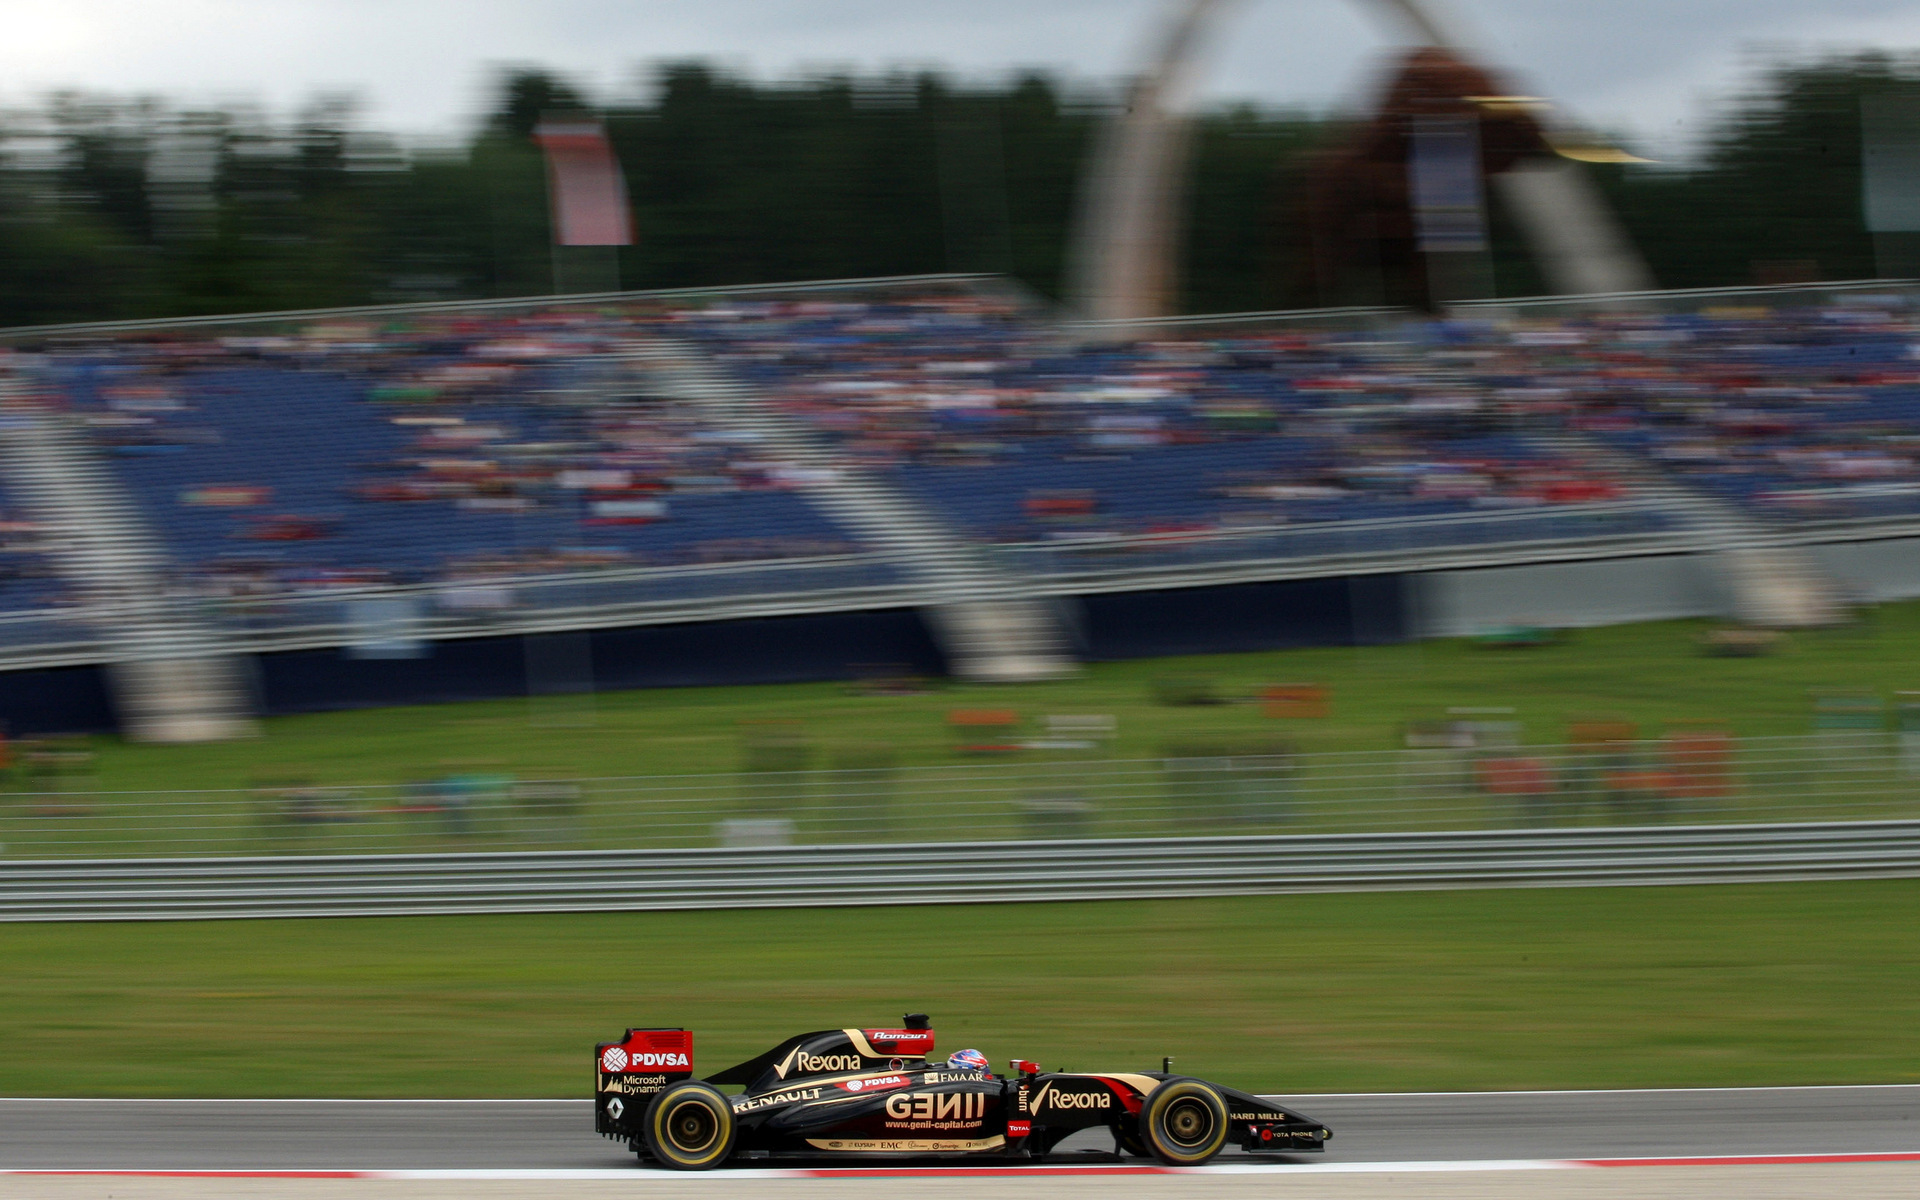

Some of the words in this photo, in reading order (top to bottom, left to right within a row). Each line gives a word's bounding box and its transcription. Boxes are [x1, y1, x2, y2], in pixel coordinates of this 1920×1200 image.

[873, 1032, 928, 1040] Romain
[632, 1053, 689, 1066] PDVSA
[797, 1051, 861, 1072] Rexona
[623, 1075, 667, 1085] Microsoft
[864, 1076, 901, 1087] PDVSA
[940, 1073, 984, 1083] EMAAR
[732, 1088, 823, 1114] RENAULT
[1018, 1090, 1030, 1112] burn
[1048, 1088, 1111, 1109] Rexona
[885, 1120, 982, 1131] www.genii-capital.com
